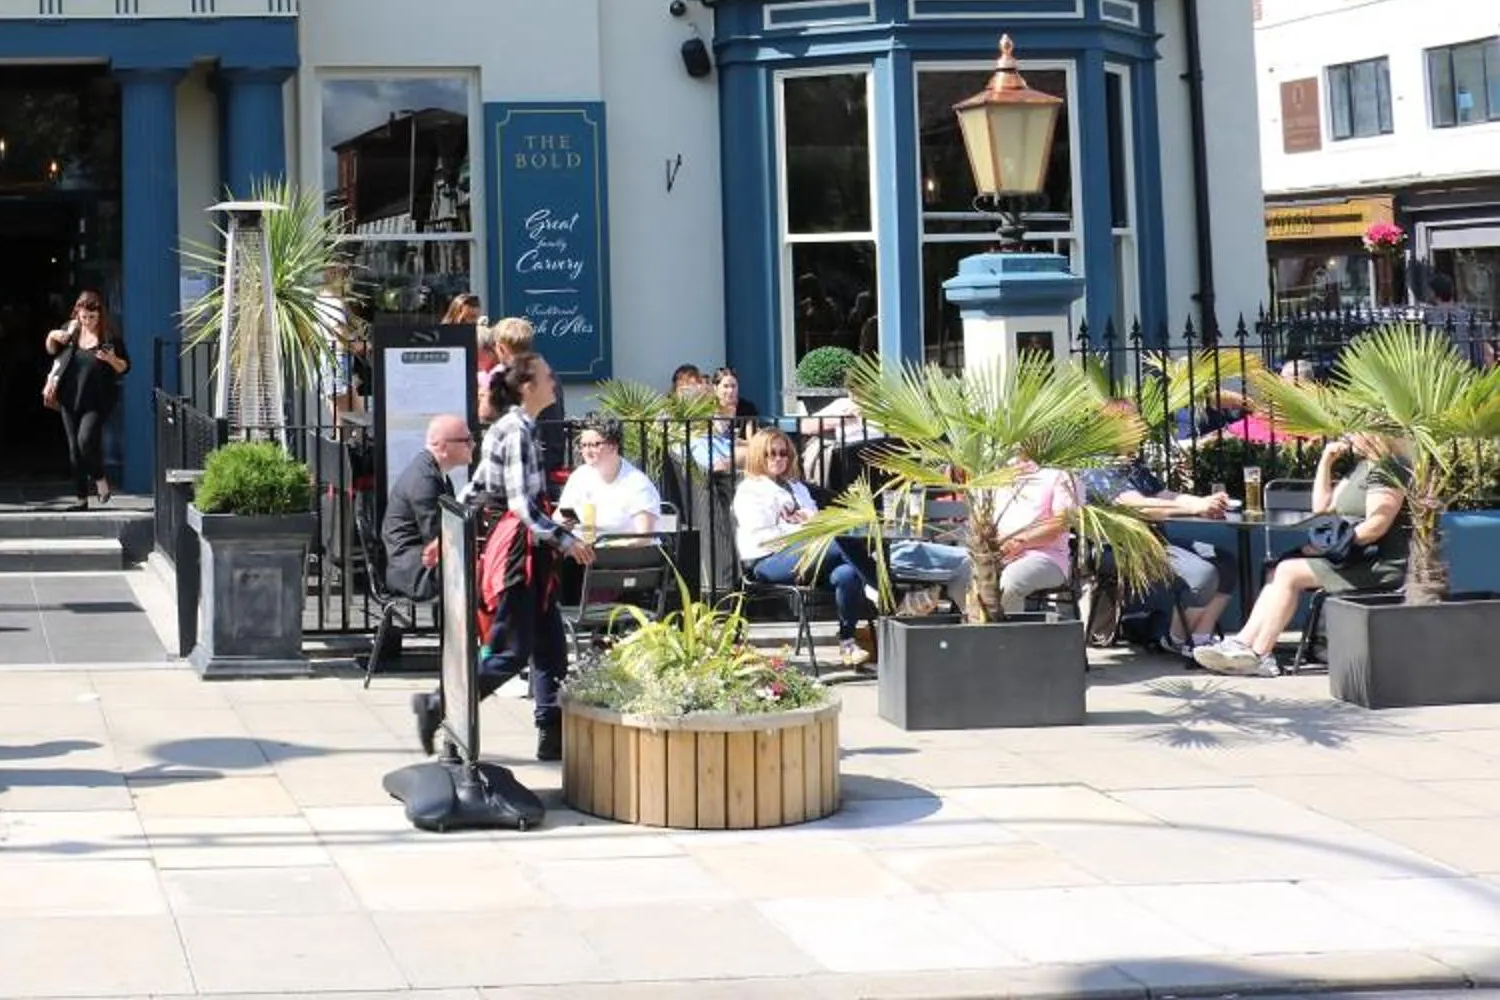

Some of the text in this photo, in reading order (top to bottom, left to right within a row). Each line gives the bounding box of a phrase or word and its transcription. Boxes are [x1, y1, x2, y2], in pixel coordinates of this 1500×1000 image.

[524, 134, 573, 149] THE
[514, 151, 582, 169] BOLD
[525, 209, 580, 241] Great
[515, 248, 584, 280] Carvery
